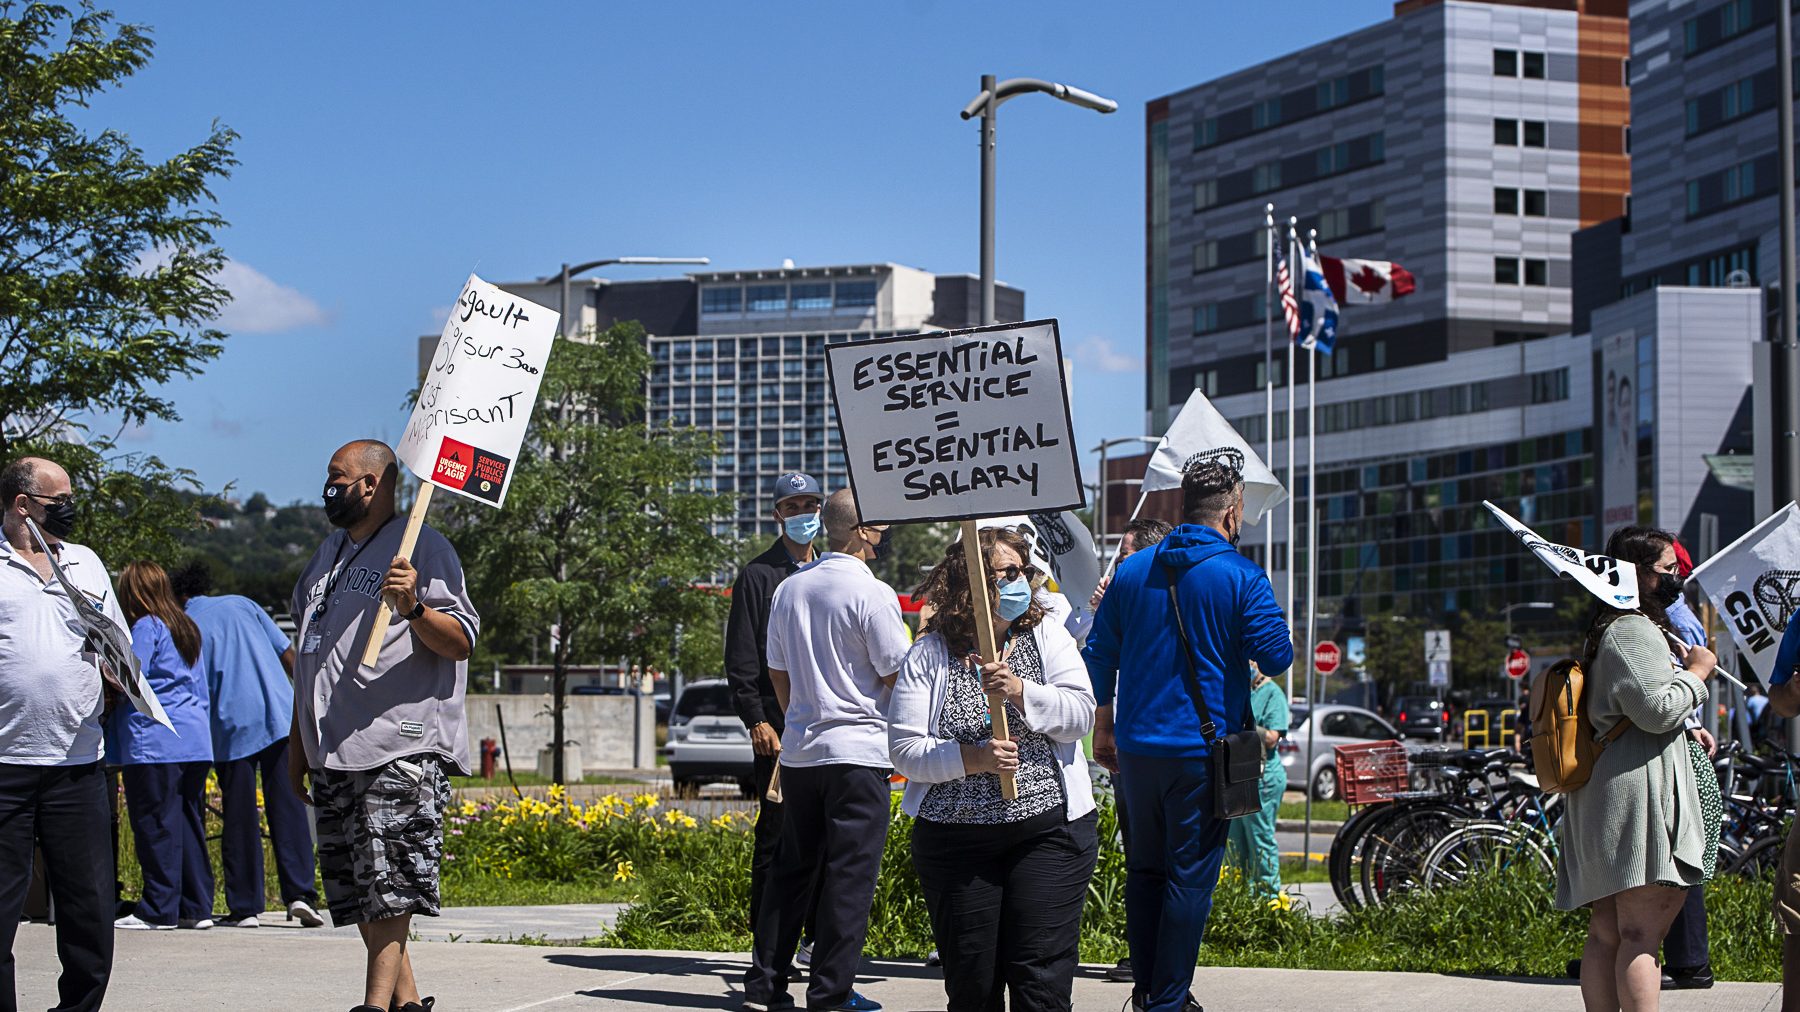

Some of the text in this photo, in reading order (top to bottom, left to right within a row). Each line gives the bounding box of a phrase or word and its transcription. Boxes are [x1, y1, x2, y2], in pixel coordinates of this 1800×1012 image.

[440, 457, 468, 473] URGENCE
[476, 462, 504, 478] PUBLICS
[479, 455, 506, 471] SERVICES
[437, 464, 465, 481] D'AGIR
[903, 462, 1039, 501] SALARY
[1724, 590, 1776, 655] CSN
